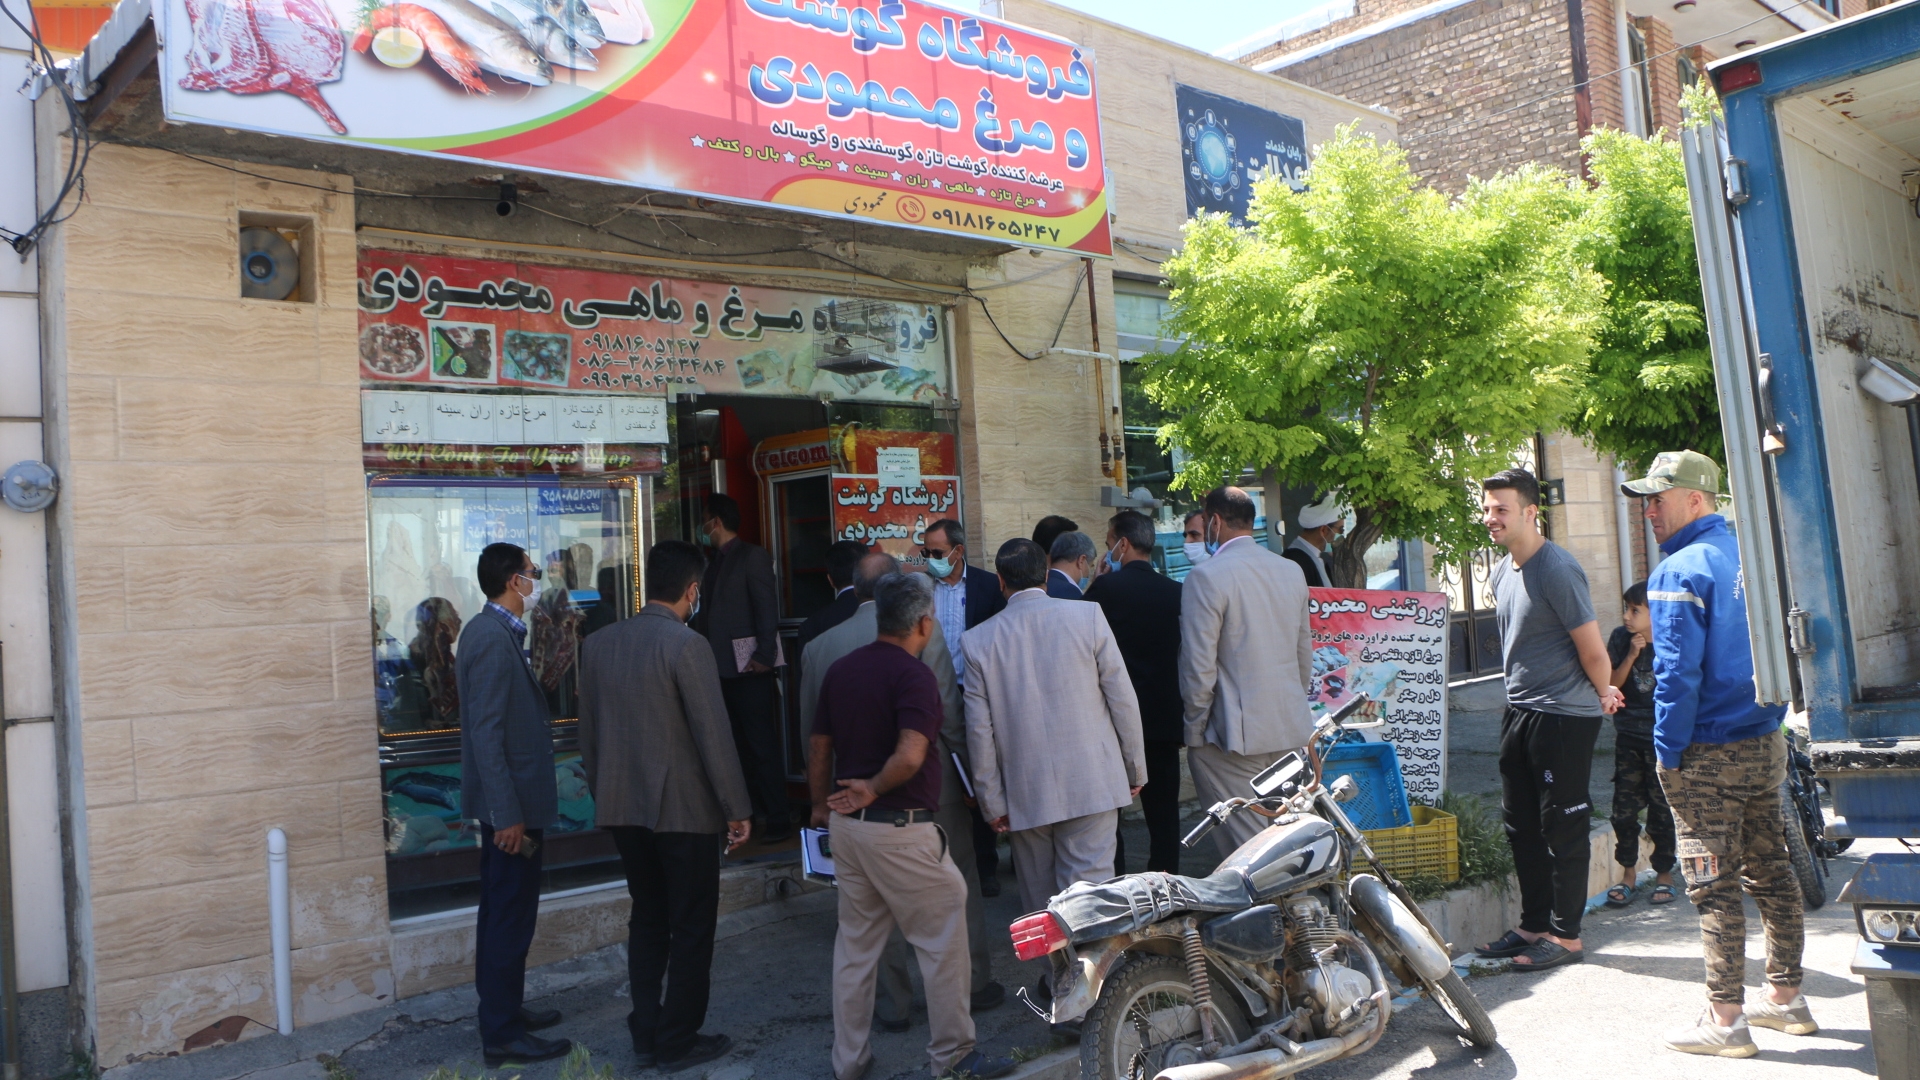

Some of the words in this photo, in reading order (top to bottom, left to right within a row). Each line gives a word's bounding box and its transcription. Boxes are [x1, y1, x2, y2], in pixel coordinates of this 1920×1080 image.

[919, 17, 1090, 100] فروشگاه
[750, 57, 959, 130] محمودی
[974, 88, 1053, 154] مرغ
[772, 122, 826, 144] گوساله
[707, 137, 740, 152] کتف
[831, 135, 840, 149] و
[845, 138, 913, 161] گوسفندی
[1065, 128, 1088, 170] و
[744, 147, 753, 157] و
[757, 146, 780, 162] بال
[918, 151, 943, 166] تازه
[800, 153, 832, 170] میگو
[947, 156, 987, 175] گوشت
[854, 164, 888, 179] سینه
[992, 167, 1026, 182] کننده
[905, 174, 928, 188] ران
[945, 183, 974, 194] ماهی
[1030, 174, 1063, 192] عرضه
[844, 191, 887, 214] محمودی
[990, 188, 1012, 202] تازه
[1014, 193, 1035, 208] مرغ
[932, 209, 1060, 242] ۰۹۱۸۱۶۰۵۲۴۷
[358, 266, 553, 318] محمودی
[562, 282, 682, 329] ماهی
[718, 287, 803, 339] مرغ
[693, 303, 710, 337] و
[584, 333, 699, 355] ۰۹۱۸۱۶۰۵۲۴۷
[389, 400, 404, 414] بال
[470, 405, 490, 419] ران
[500, 405, 520, 419] تازه
[523, 405, 546, 421] مرغ
[563, 404, 577, 415] تازه
[580, 404, 603, 416] گوشت
[620, 404, 634, 416] تازه
[636, 404, 659, 417] گوشت
[376, 421, 419, 435] زعفرانی
[572, 419, 596, 431] گوساله
[625, 419, 656, 431] گوسفندی
[752, 445, 829, 471] Welcom
[837, 483, 887, 512] گوشت
[892, 482, 955, 512] فروشگاه
[837, 521, 908, 546] محمودی
[1309, 598, 1367, 619] محمود
[1372, 597, 1445, 628] پروتئینی
[1333, 630, 1351, 643] های
[1354, 632, 1388, 644] فراورده
[1391, 633, 1415, 643] کننده
[1418, 634, 1442, 646] عرضه
[1360, 647, 1380, 662] مرغ
[1404, 649, 1423, 664] تازه
[1423, 648, 1442, 664] مرغ
[1396, 669, 1417, 683] سینه
[1417, 673, 1424, 684] و
[1425, 669, 1443, 684] ران
[1418, 693, 1425, 703] و
[1426, 689, 1441, 703] دل
[1387, 709, 1425, 724] زعفرانی
[1425, 710, 1441, 724] بال
[1382, 727, 1420, 743] زعفرانی
[1413, 747, 1441, 760] جوجه
